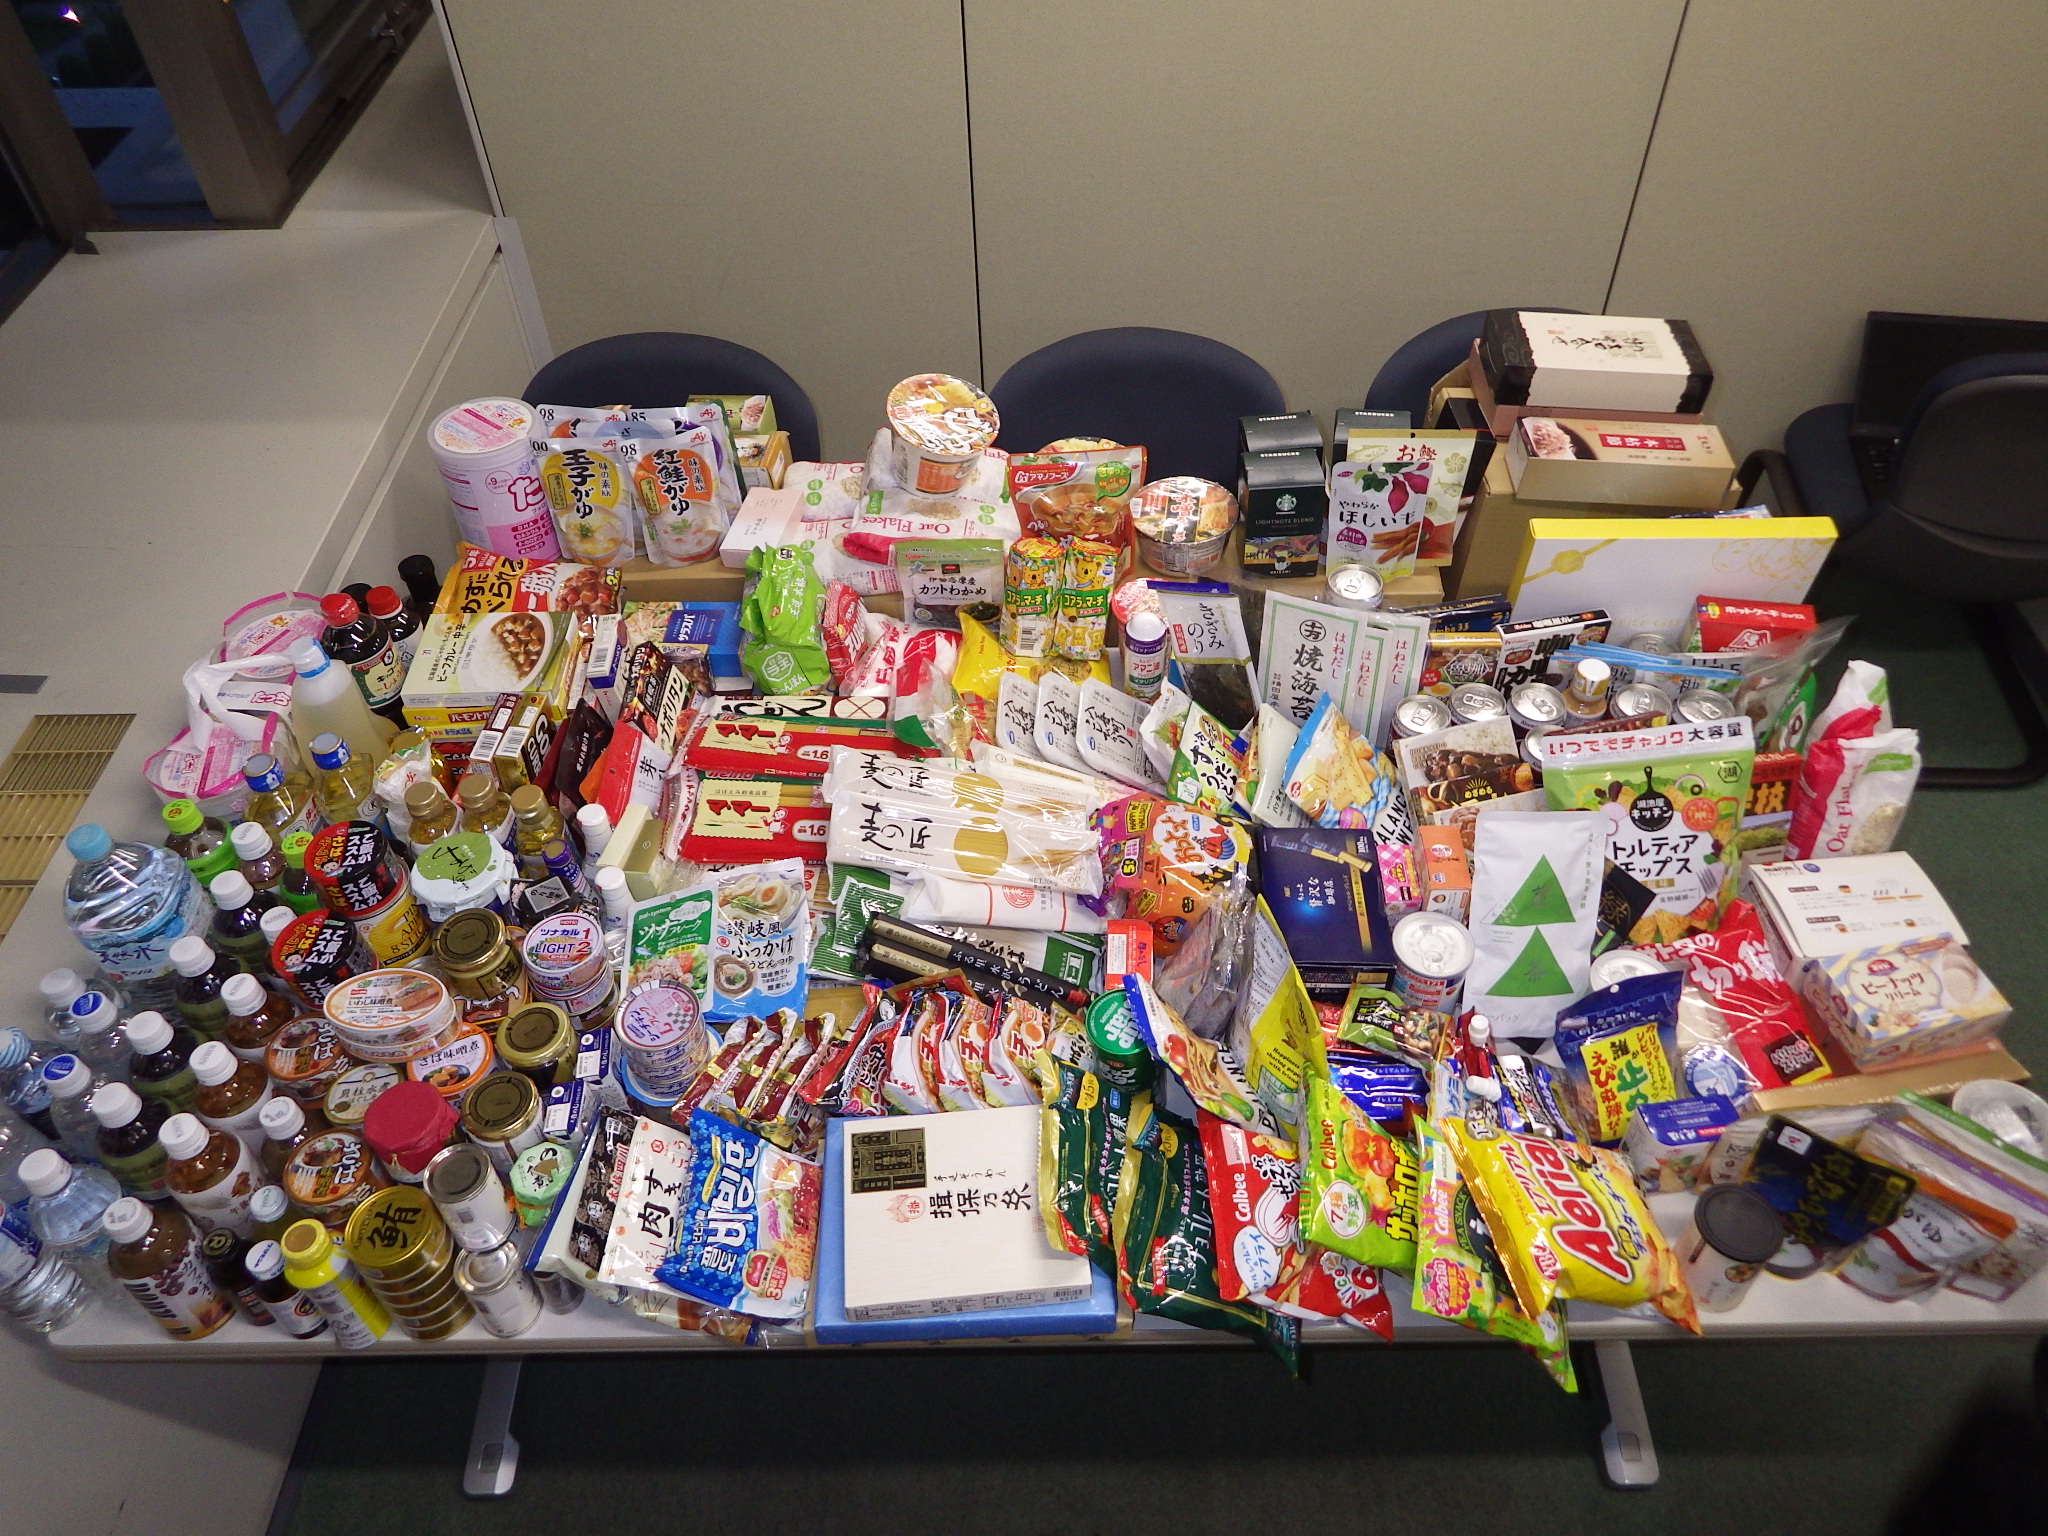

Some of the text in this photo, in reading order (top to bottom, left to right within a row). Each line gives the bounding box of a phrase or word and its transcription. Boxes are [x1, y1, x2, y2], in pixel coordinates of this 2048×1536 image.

[540, 408, 554, 421] 98
[1258, 414, 1297, 422] STARBUCKS
[620, 443, 637, 456] 98
[562, 449, 596, 519] 玉子がゆ
[652, 449, 690, 516] 紅鮭がゆ
[1029, 472, 1070, 480] アマノフーズ
[1338, 500, 1380, 510] やわらか
[862, 516, 950, 535] Flakes Oat
[918, 584, 986, 596] カットわかめ
[1006, 590, 1042, 606] コアラのマーチ
[1064, 592, 1104, 609] コアラのマーチ
[436, 641, 460, 682] ビーフカレー
[1331, 632, 1346, 680] はねだし
[1392, 640, 1407, 685] はねだし
[1291, 644, 1324, 720] 焼海苔
[1357, 650, 1372, 698] はねだし
[659, 672, 686, 740] ナポリタン
[714, 724, 776, 742] ママー
[1549, 730, 1684, 754] いつでもチャック
[1688, 722, 1743, 741] 大容量
[812, 750, 829, 760] 1.6
[706, 799, 770, 817] ママー
[1631, 808, 1672, 819] キッチン
[808, 824, 826, 836] 1.6
[1826, 822, 1850, 853] Oat
[1612, 834, 1700, 860] トルティア
[1308, 876, 1324, 909] 贅沢な
[540, 928, 580, 936] ツナカル
[726, 922, 782, 938] 讃岐風
[534, 943, 576, 954] LIGHT
[731, 934, 793, 960] ぶっかけ
[418, 1040, 480, 1066] さば味噌煮
[1272, 1046, 1300, 1068] Happiness
[1320, 1118, 1336, 1170] Calbee
[1499, 1140, 1558, 1218] エアリアル
[929, 1182, 1032, 1220] 揖保乃糸
[1232, 1172, 1251, 1222] Calbee
[1514, 1132, 1633, 1284] Aerial
[1434, 1188, 1450, 1236] Calbee
[1454, 1192, 1468, 1231] SNACK
